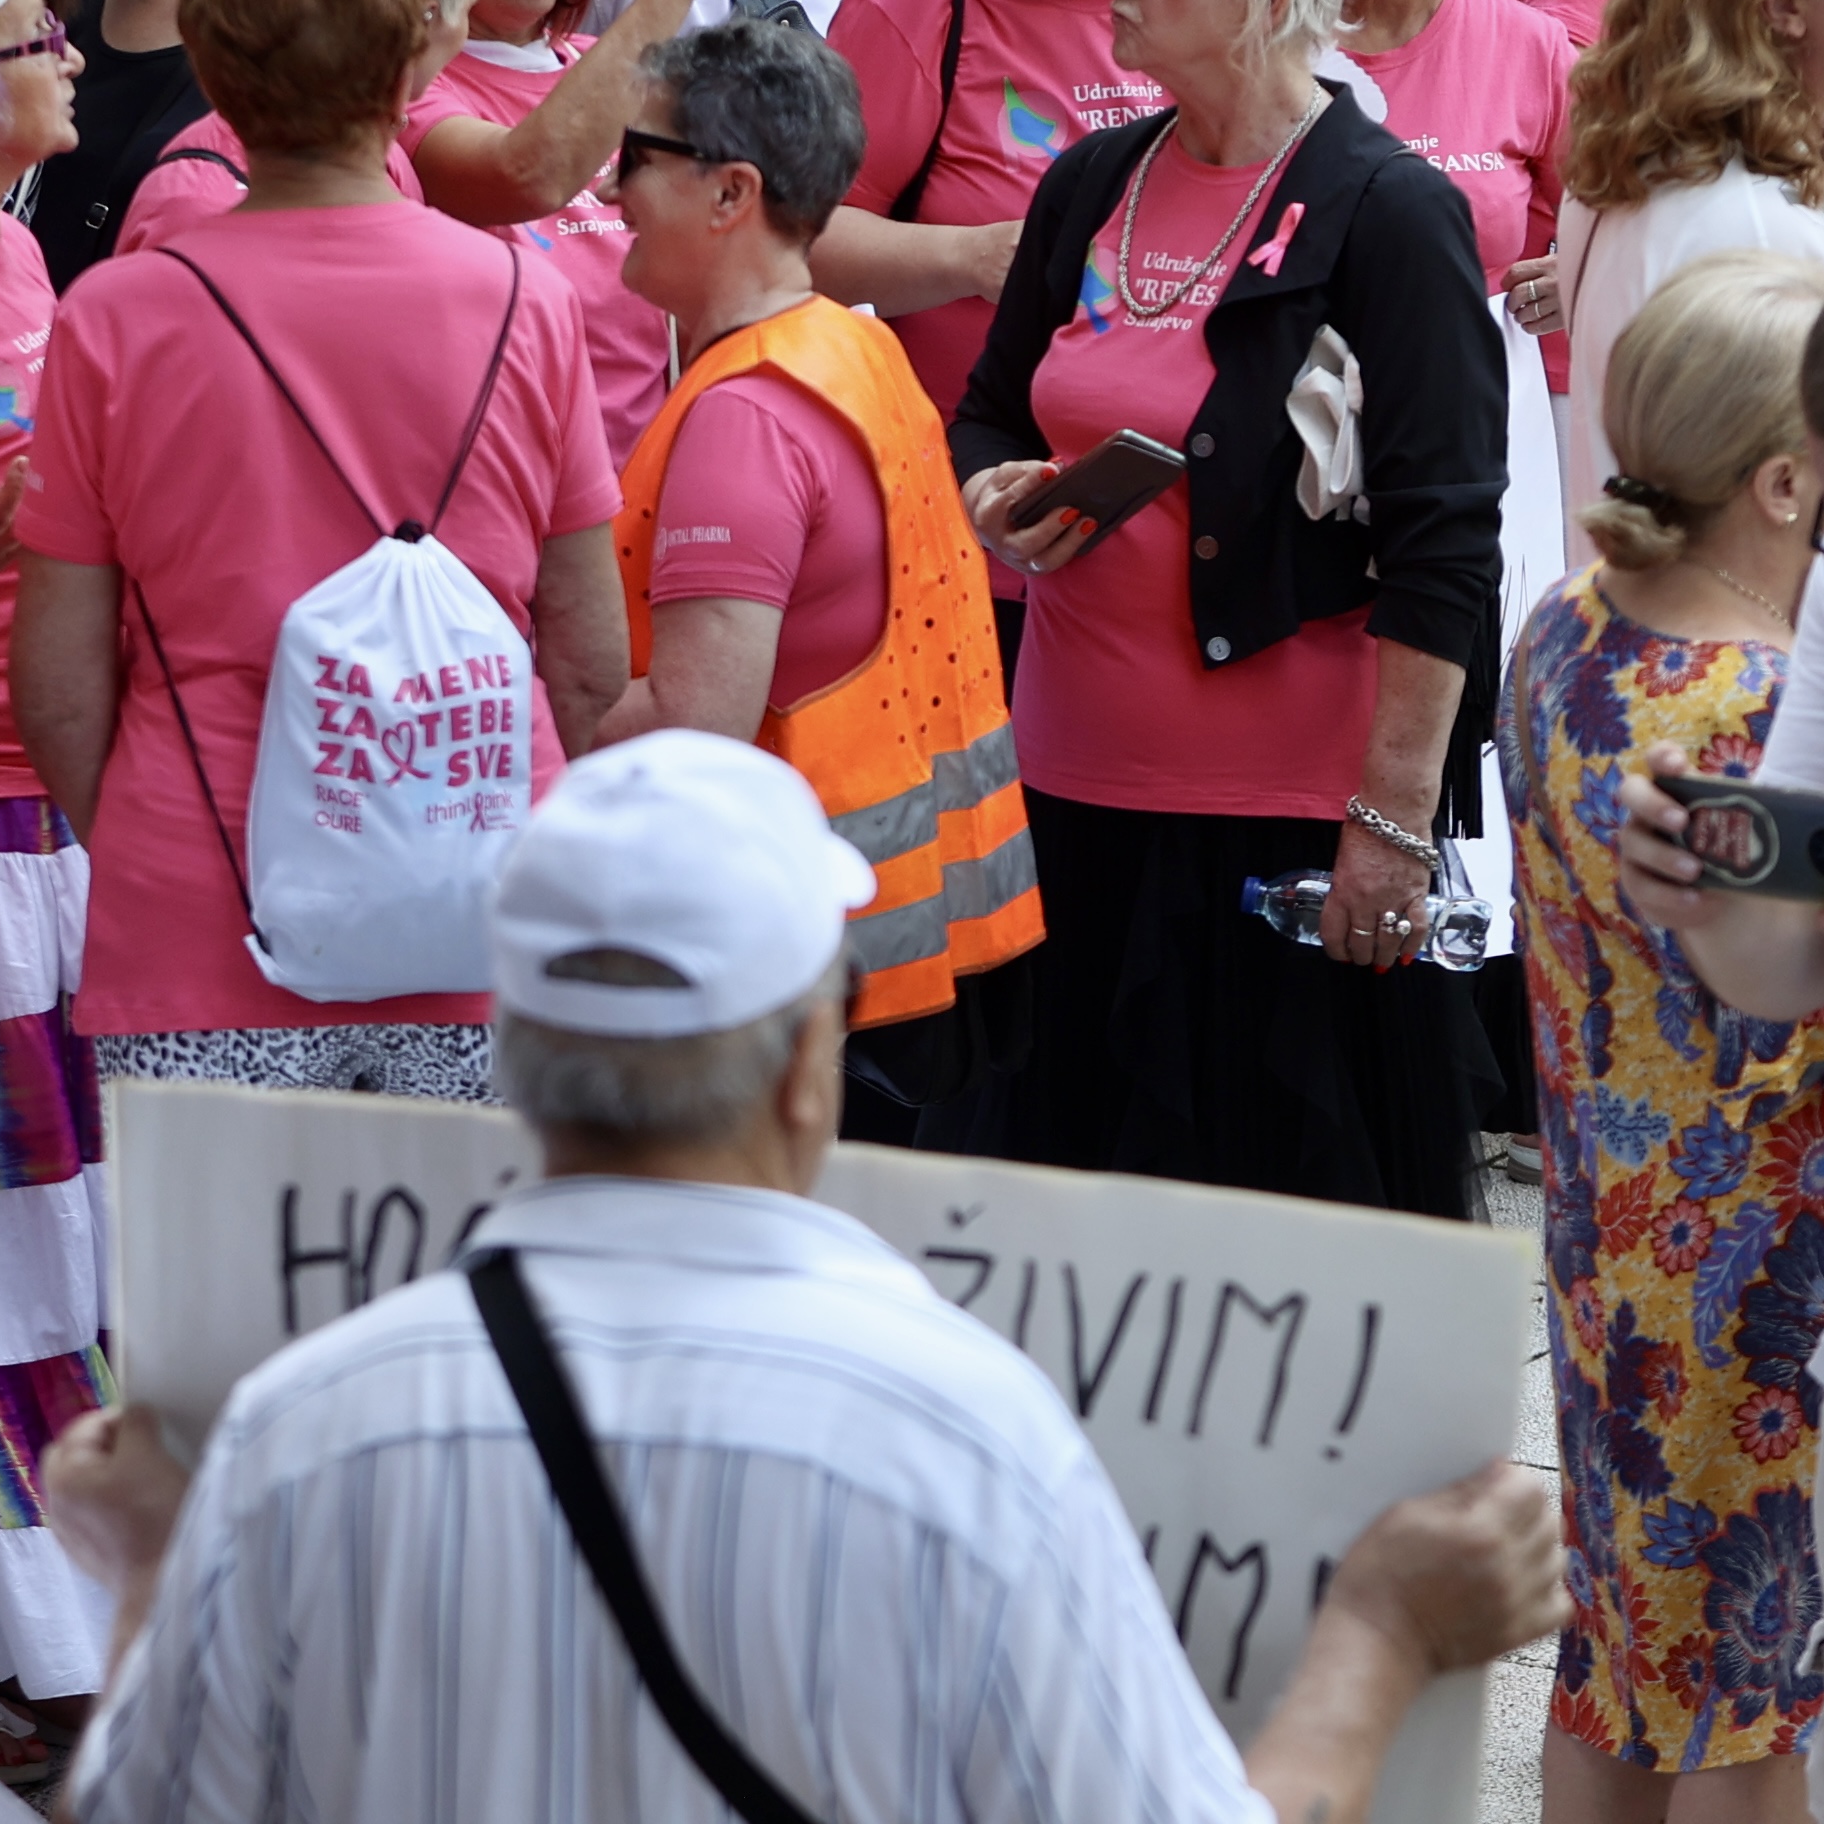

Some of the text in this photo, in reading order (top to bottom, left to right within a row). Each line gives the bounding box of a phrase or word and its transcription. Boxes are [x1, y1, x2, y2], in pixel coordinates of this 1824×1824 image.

[1072, 80, 1163, 103] Udruženje
[556, 216, 626, 237] Sarajevo
[314, 654, 512, 704] ZA MENE
[315, 698, 514, 748] ZA TEBE
[313, 741, 514, 788] ZA SVE
